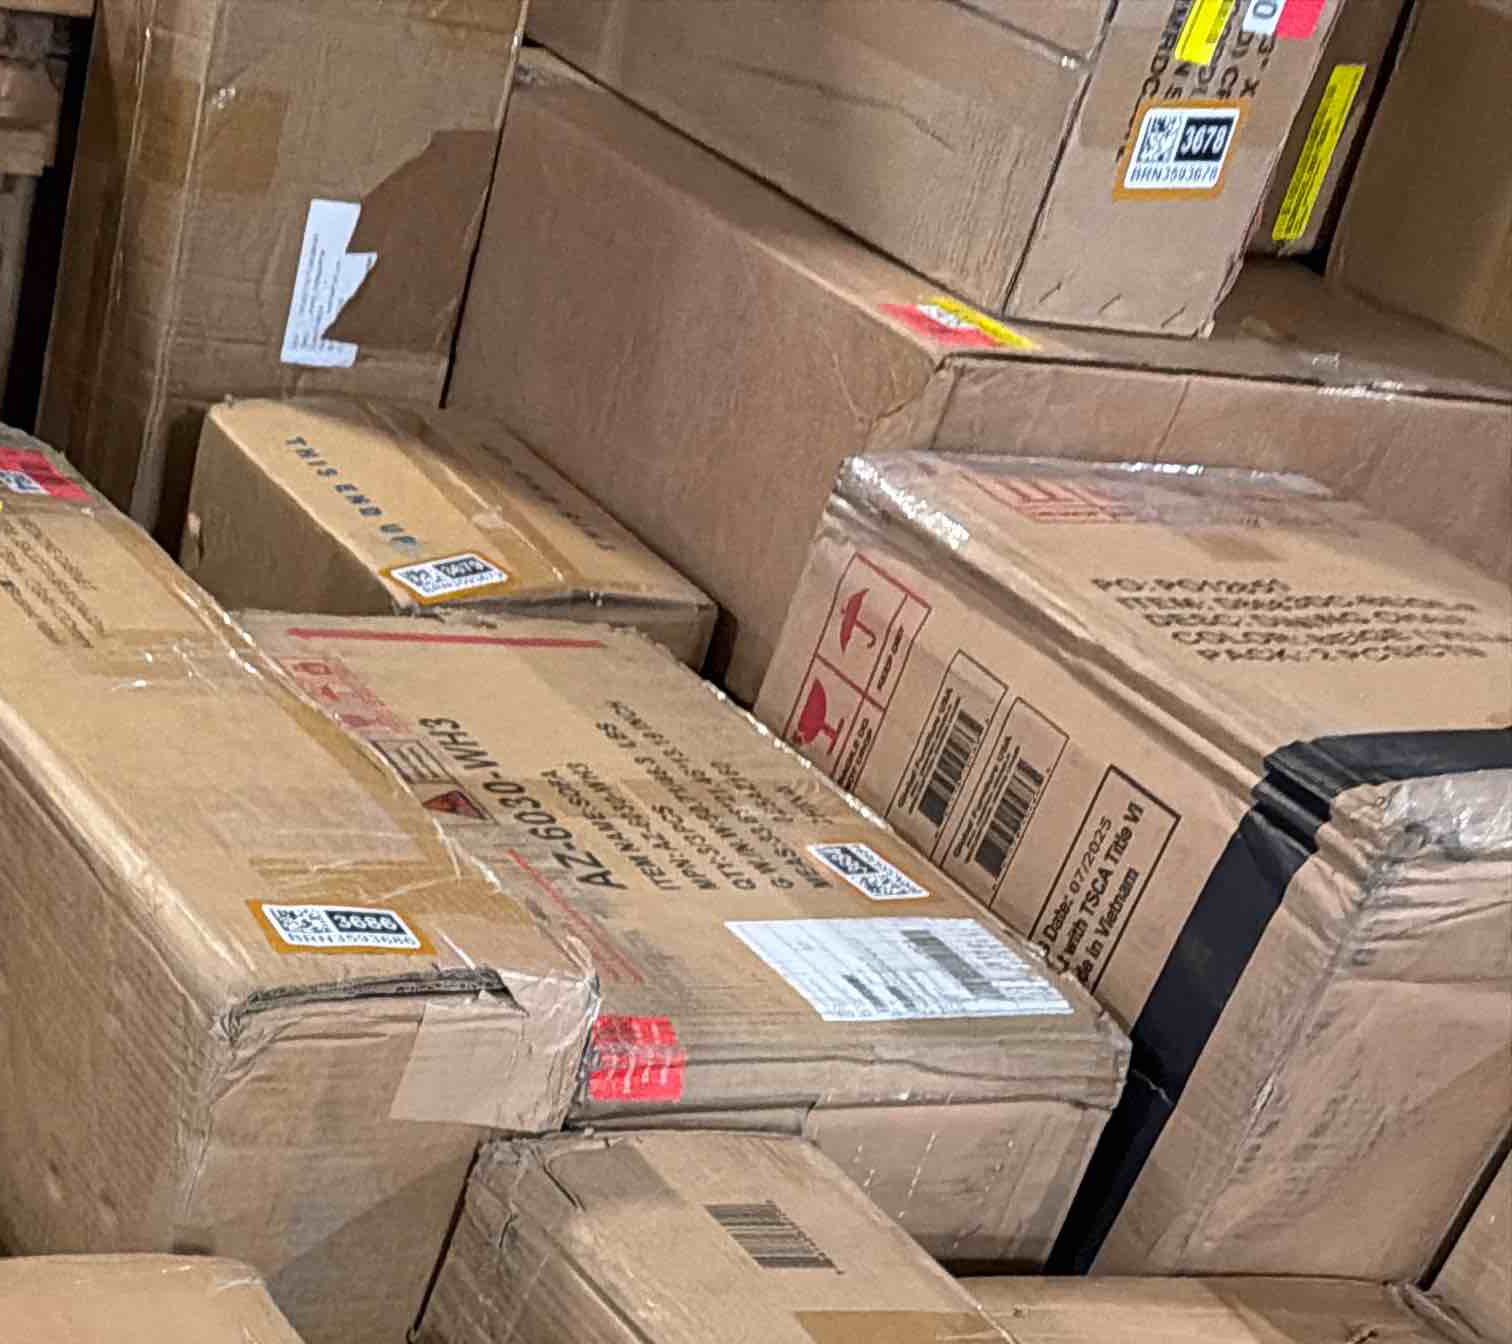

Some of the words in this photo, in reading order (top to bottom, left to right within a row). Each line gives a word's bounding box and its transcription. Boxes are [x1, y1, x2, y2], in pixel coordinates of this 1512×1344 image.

[285, 436, 338, 477] THIS
[335, 483, 383, 518] END
[380, 522, 418, 547] UP
[419, 717, 628, 890] AZ-6030-WH3
[1043, 894, 1075, 943] Date:
[1069, 816, 1112, 894] 07/2025
[1064, 919, 1089, 956] with
[1079, 867, 1114, 917] TSCA
[1104, 826, 1133, 865] Title
[1123, 801, 1145, 824] VI
[1095, 867, 1140, 938] Vietnam
